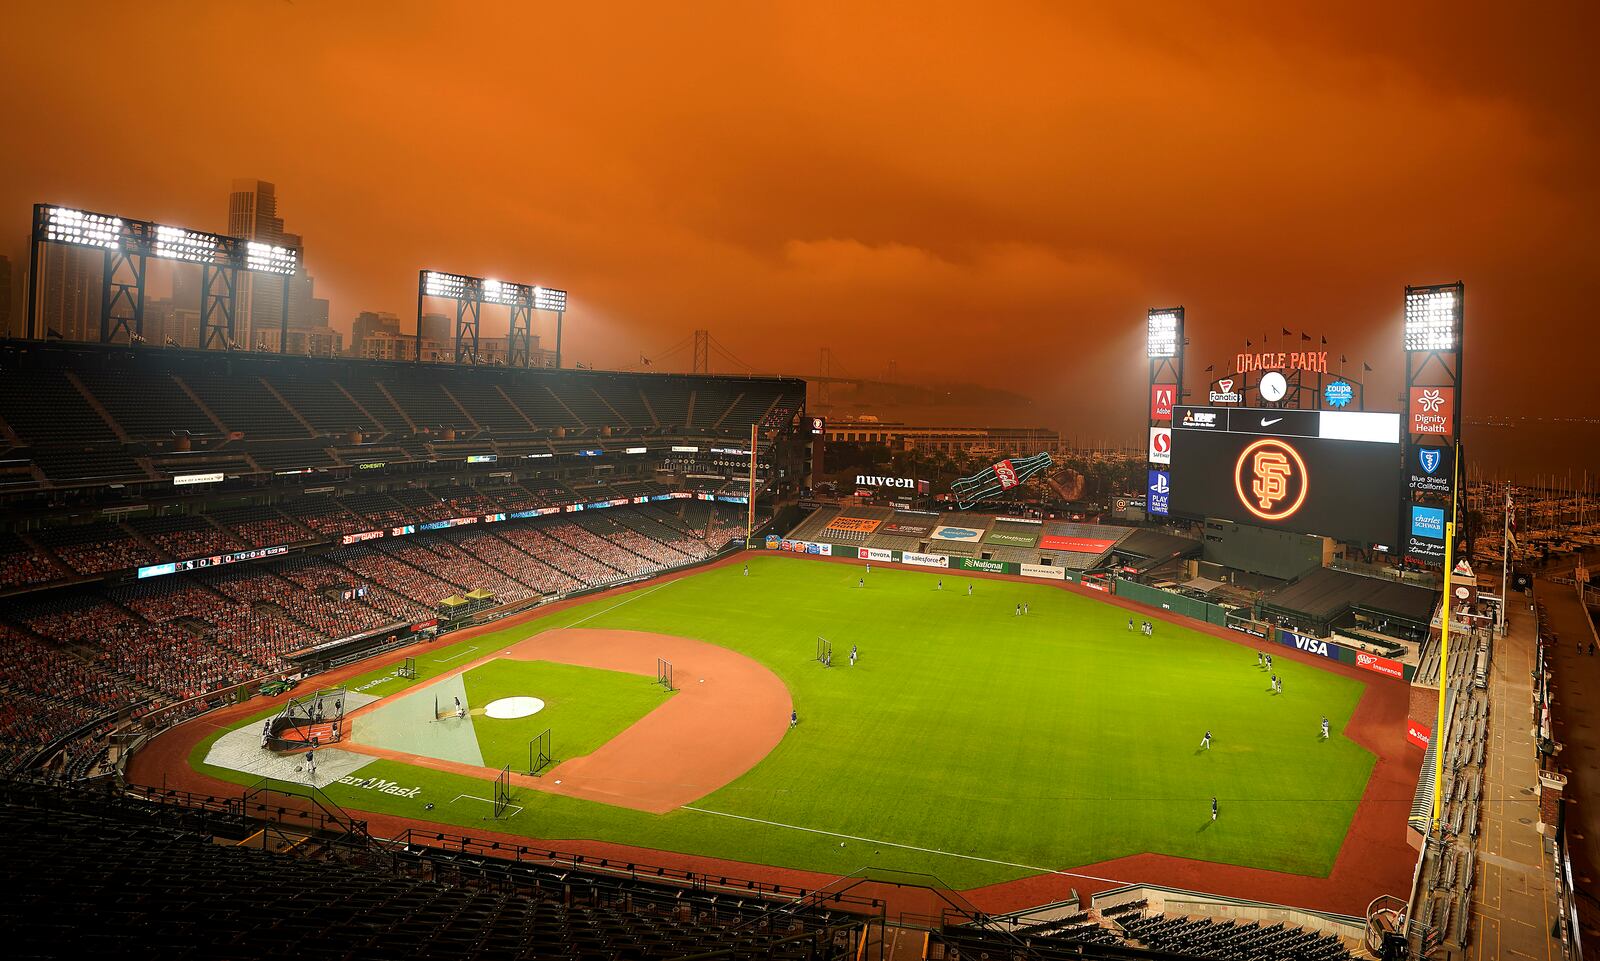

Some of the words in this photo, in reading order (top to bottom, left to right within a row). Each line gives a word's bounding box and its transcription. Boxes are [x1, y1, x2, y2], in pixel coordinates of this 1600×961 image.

[1236, 353, 1286, 374] ORACLE
[1290, 351, 1328, 374] PARK
[1327, 385, 1351, 394] coupa
[1415, 414, 1446, 424] Dignity
[360, 462, 386, 470] COHESITY
[856, 475, 915, 489] nuveen
[1411, 475, 1425, 483] Blue
[1427, 477, 1447, 485] Shield
[1417, 482, 1450, 492] California
[1152, 494, 1168, 503] PLAY
[1415, 514, 1440, 524] charles
[1415, 521, 1440, 530] SCHWAB
[361, 531, 384, 541] GIANTS
[870, 551, 890, 559] TOYOTA
[911, 555, 939, 564] salesforce
[973, 560, 1004, 569] National
[1291, 634, 1329, 657] VISA
[1373, 663, 1402, 677] Insurance
[378, 779, 422, 799] Mask
